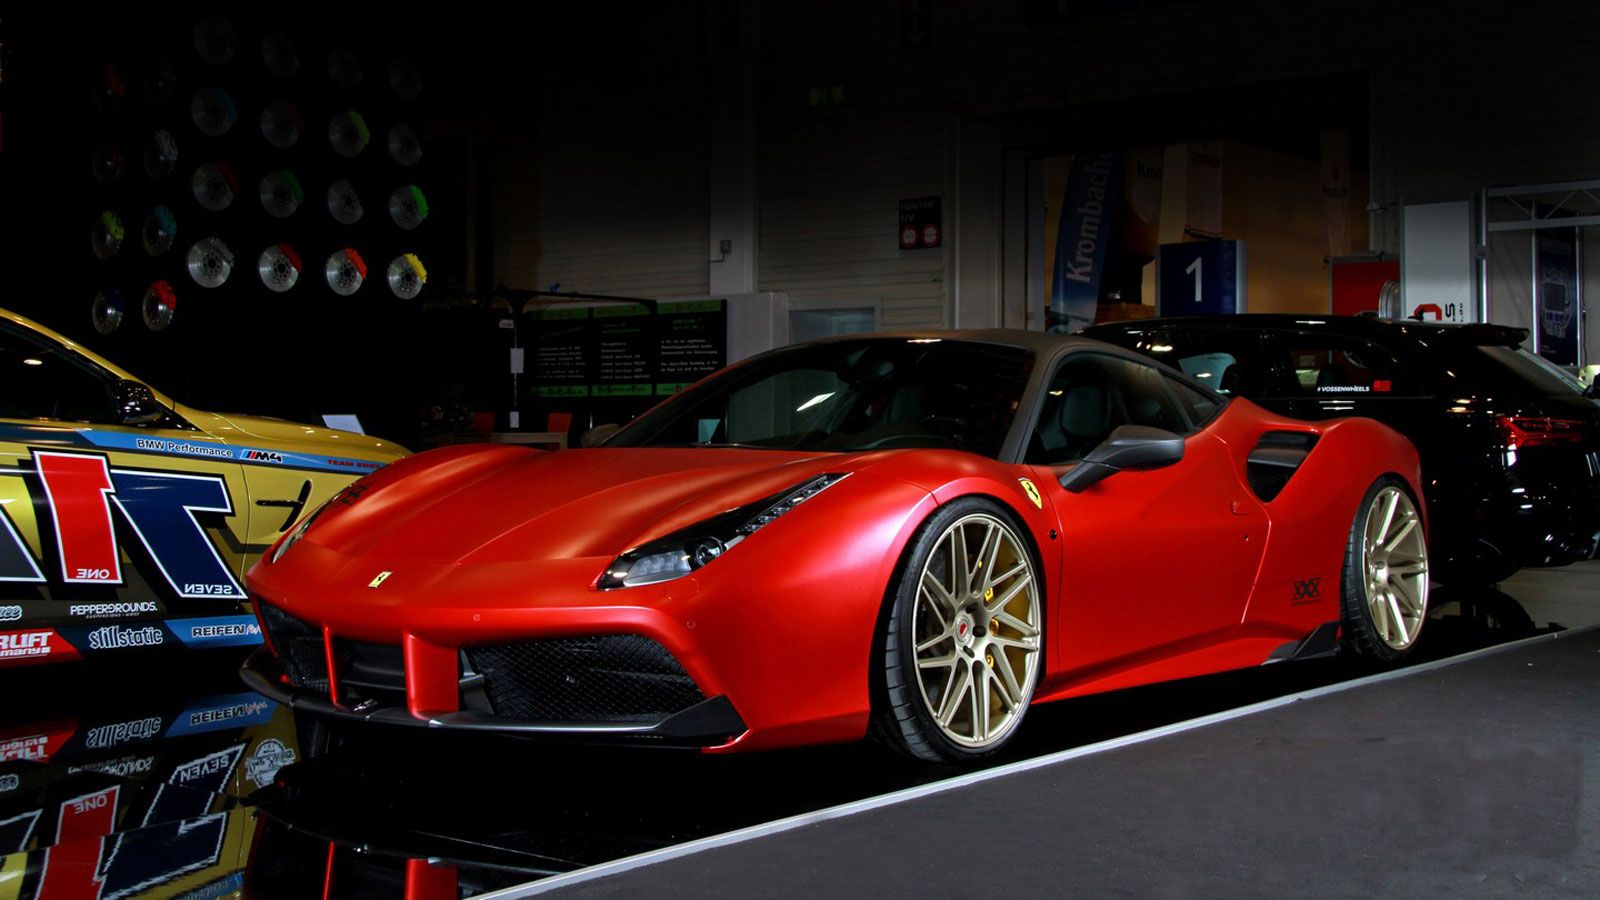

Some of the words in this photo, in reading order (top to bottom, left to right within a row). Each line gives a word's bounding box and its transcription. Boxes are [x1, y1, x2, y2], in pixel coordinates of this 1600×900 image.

[1185, 256, 1204, 303] 1
[137, 437, 165, 450] BMW
[167, 440, 233, 458] Performance
[253, 450, 284, 463] M4
[88, 625, 163, 650] stillstatic
[192, 624, 244, 638] REIFEN
